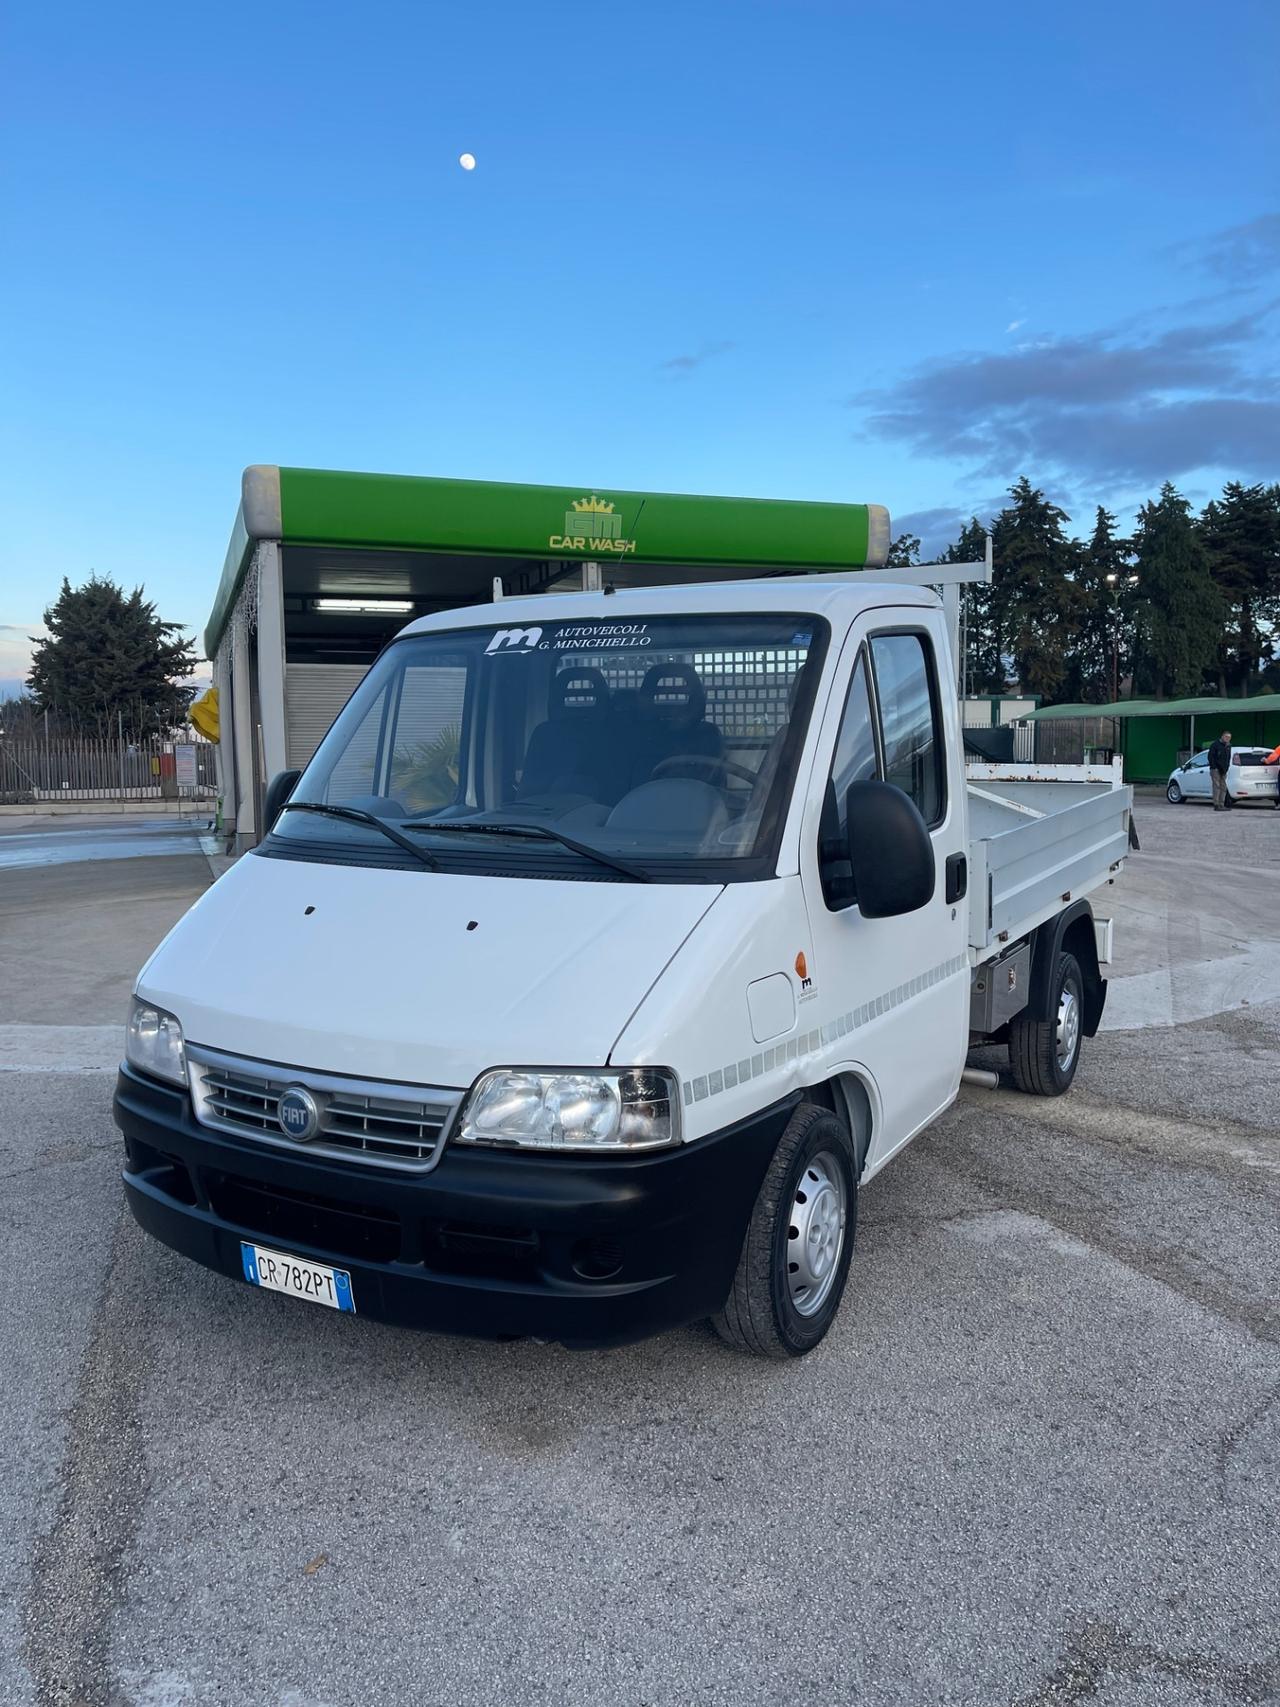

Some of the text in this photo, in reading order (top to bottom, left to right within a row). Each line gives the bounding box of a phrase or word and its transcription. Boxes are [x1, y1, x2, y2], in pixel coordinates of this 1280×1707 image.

[549, 535, 636, 553] CAR WASH
[555, 624, 647, 638] AUTOVEICOLI
[539, 636, 651, 650] G. MINICHIELLO
[282, 1105, 307, 1125] FIAT
